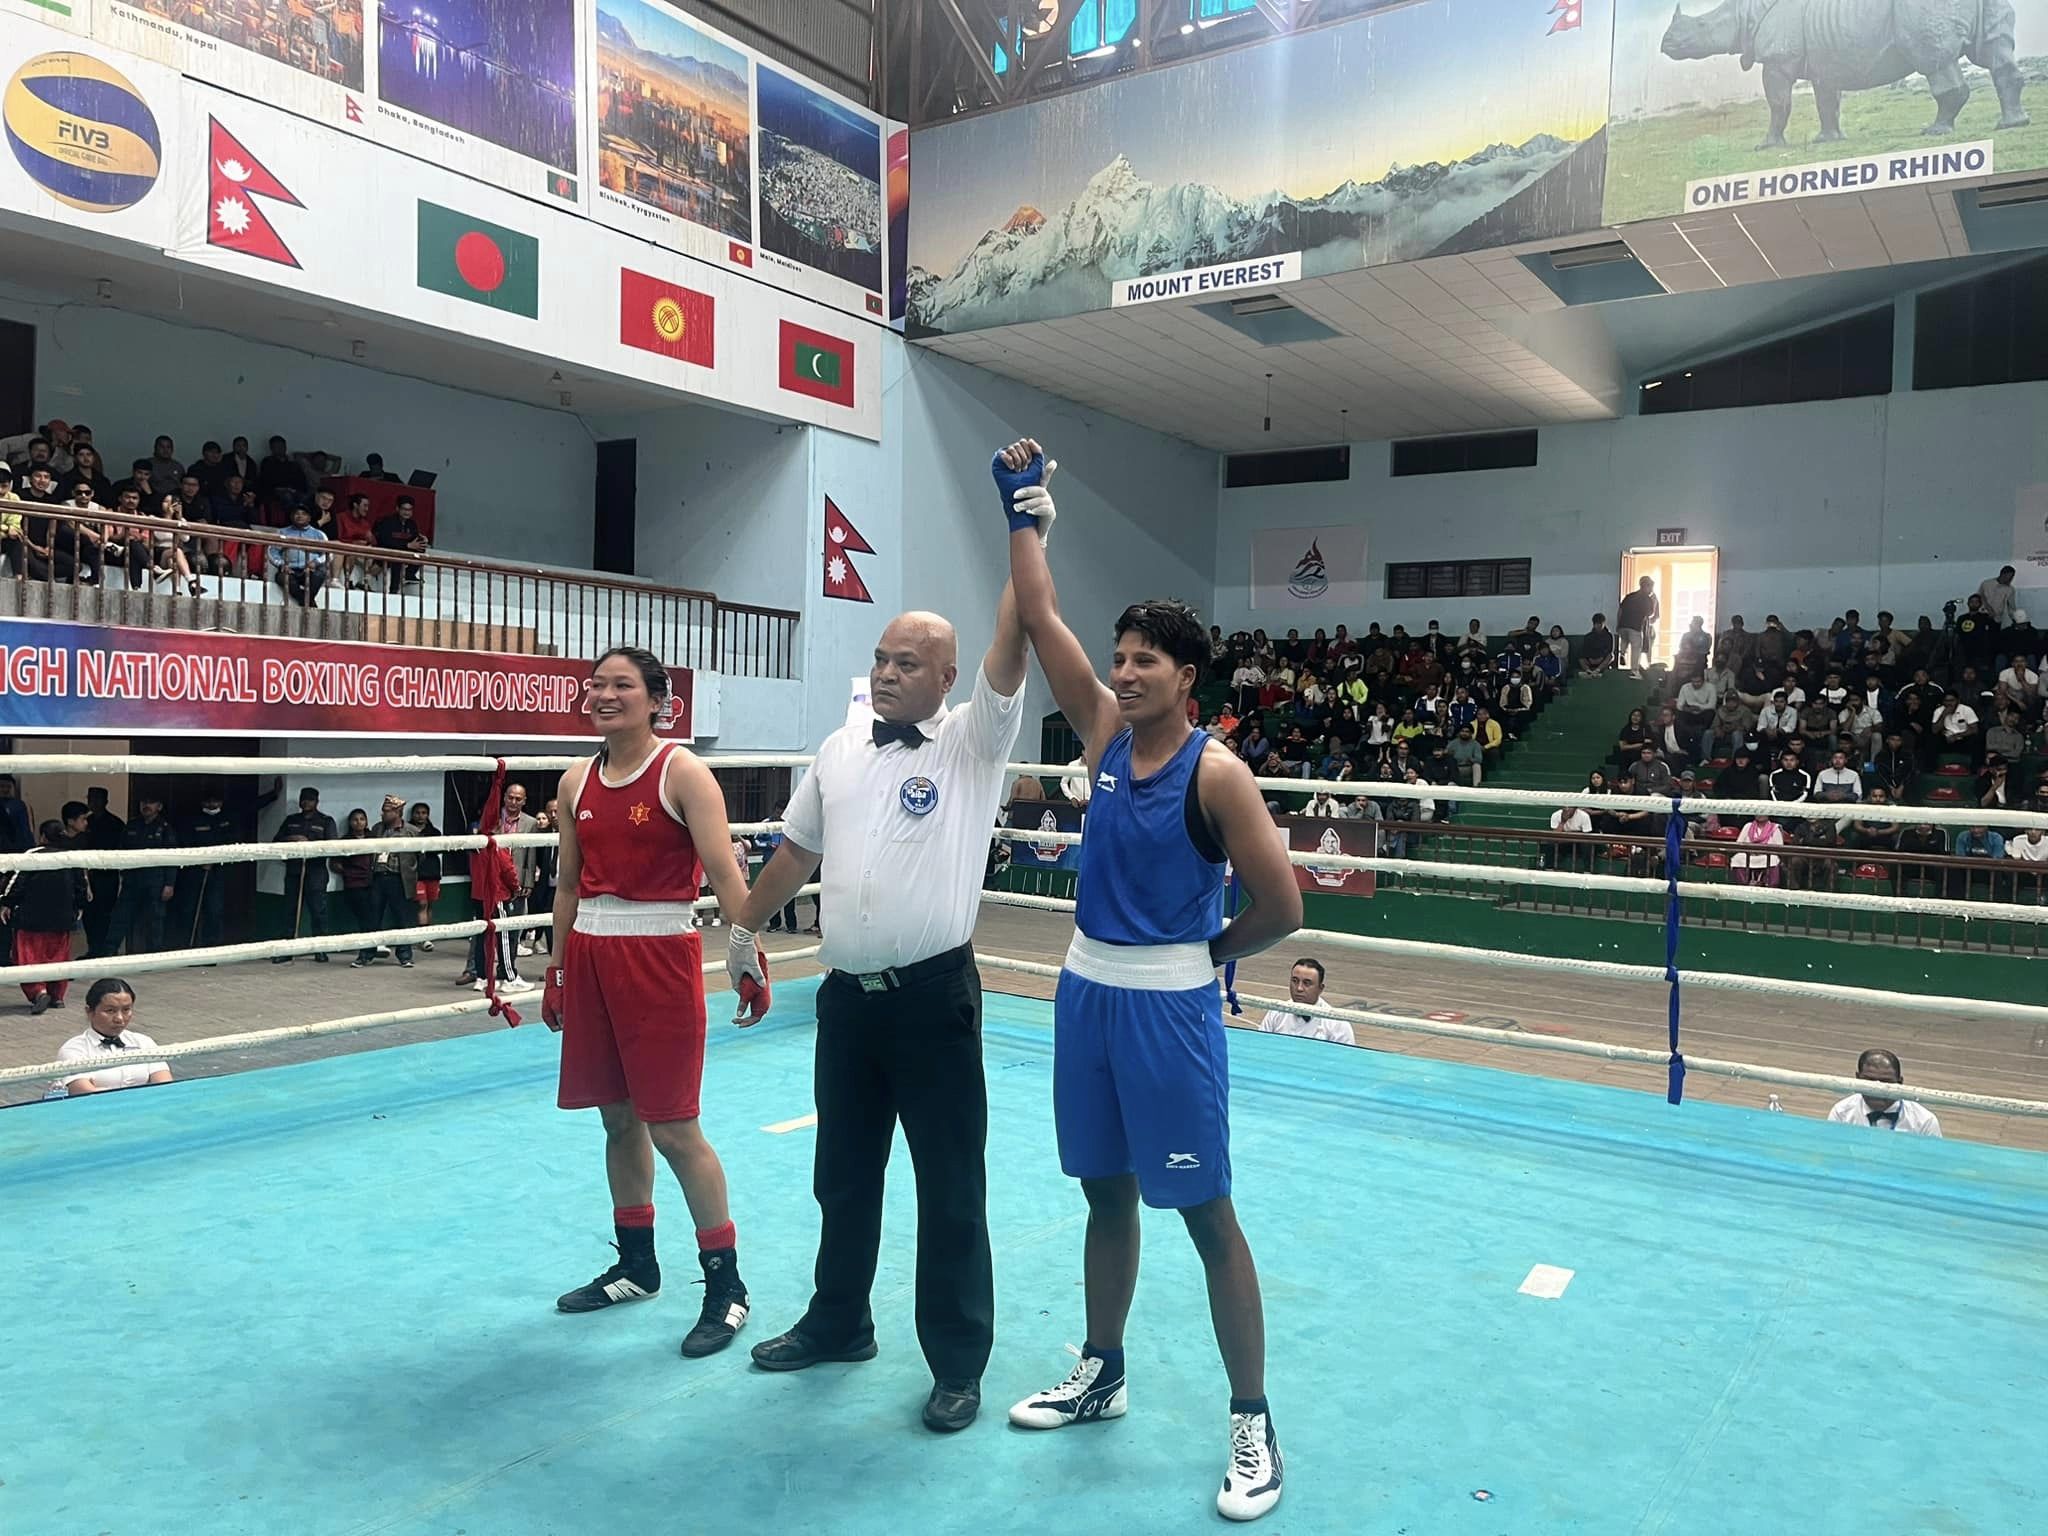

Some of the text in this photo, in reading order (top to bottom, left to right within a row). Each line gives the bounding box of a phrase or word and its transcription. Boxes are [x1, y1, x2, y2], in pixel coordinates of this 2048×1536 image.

[110, 5, 217, 51] Kathmandu, Nepal
[58, 119, 110, 150] FIVB
[377, 105, 465, 144] Dhaka, Bangladesh
[1692, 148, 1985, 206] ONE HORNED RHINO
[1127, 260, 1285, 301] MOUNT EVEREST
[1660, 532, 1681, 544] EXIT
[77, 649, 257, 702] NATIONAL
[263, 659, 380, 707] BOXING
[384, 665, 579, 714] CHAMPIONSHIP
